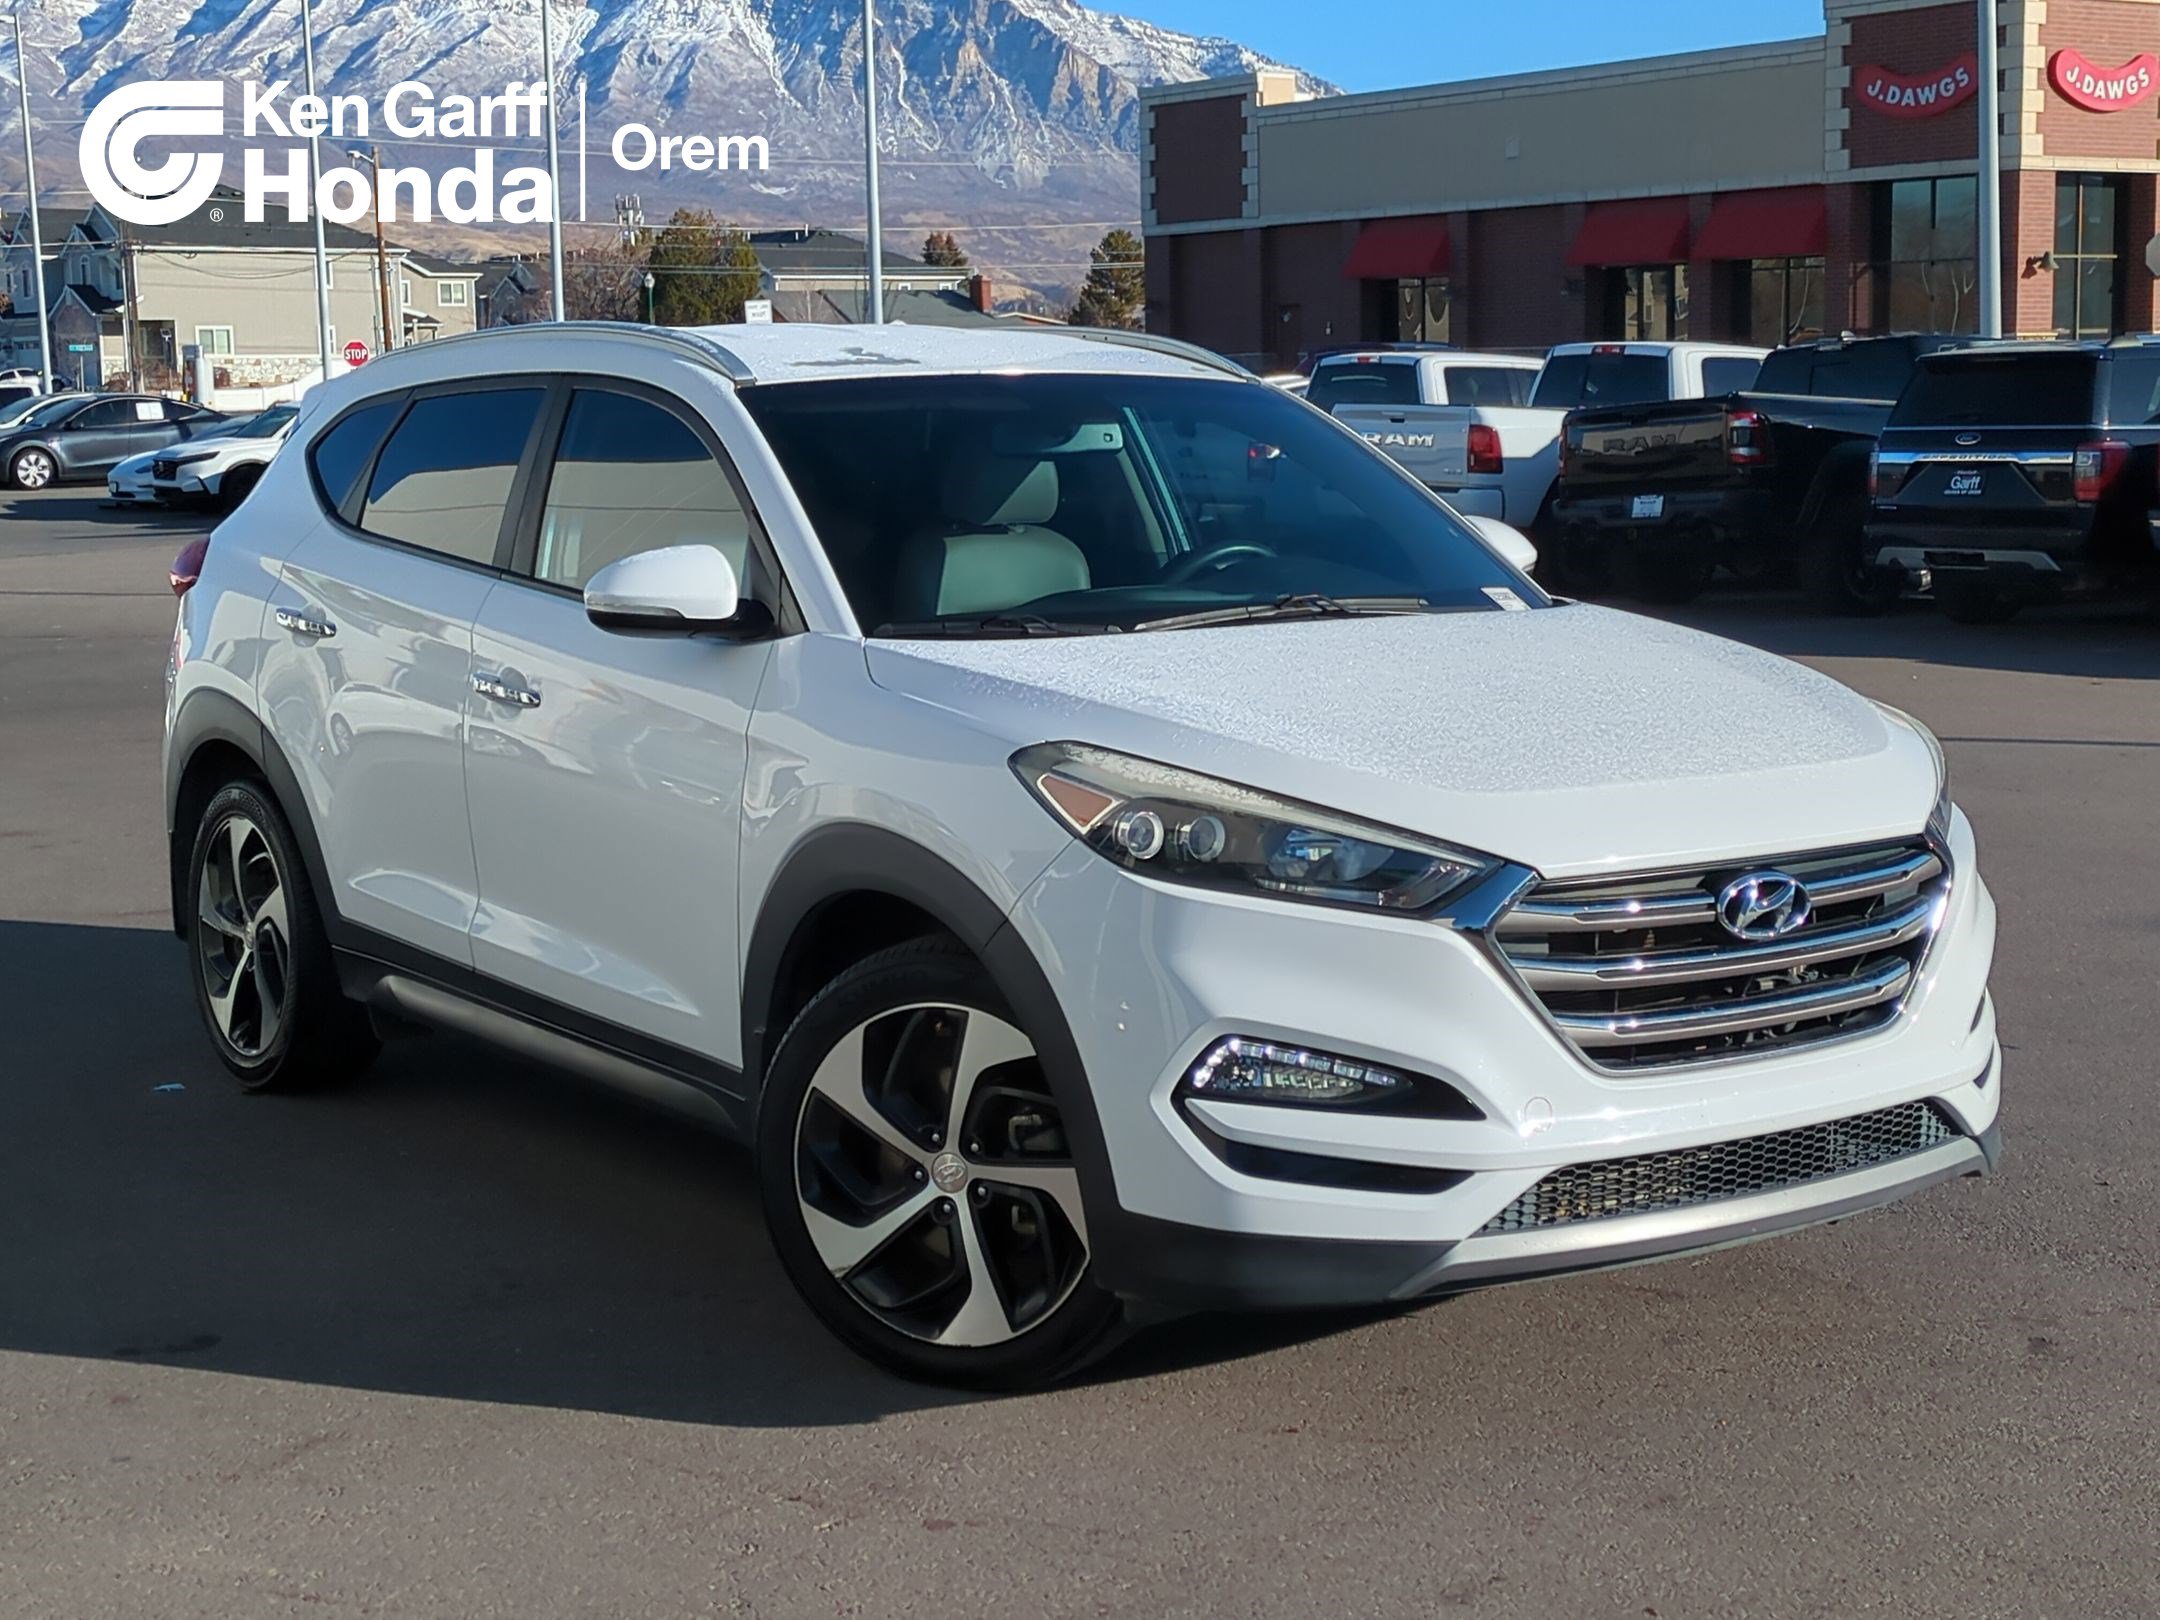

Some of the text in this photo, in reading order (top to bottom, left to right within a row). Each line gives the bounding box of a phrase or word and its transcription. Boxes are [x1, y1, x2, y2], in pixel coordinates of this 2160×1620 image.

[1866, 66, 1969, 107] J.DAWGS
[2065, 66, 2150, 100] J.DAWGS
[345, 348, 368, 360] STOP
[1362, 431, 1435, 447] RAM
[1950, 475, 1981, 489] Garff
